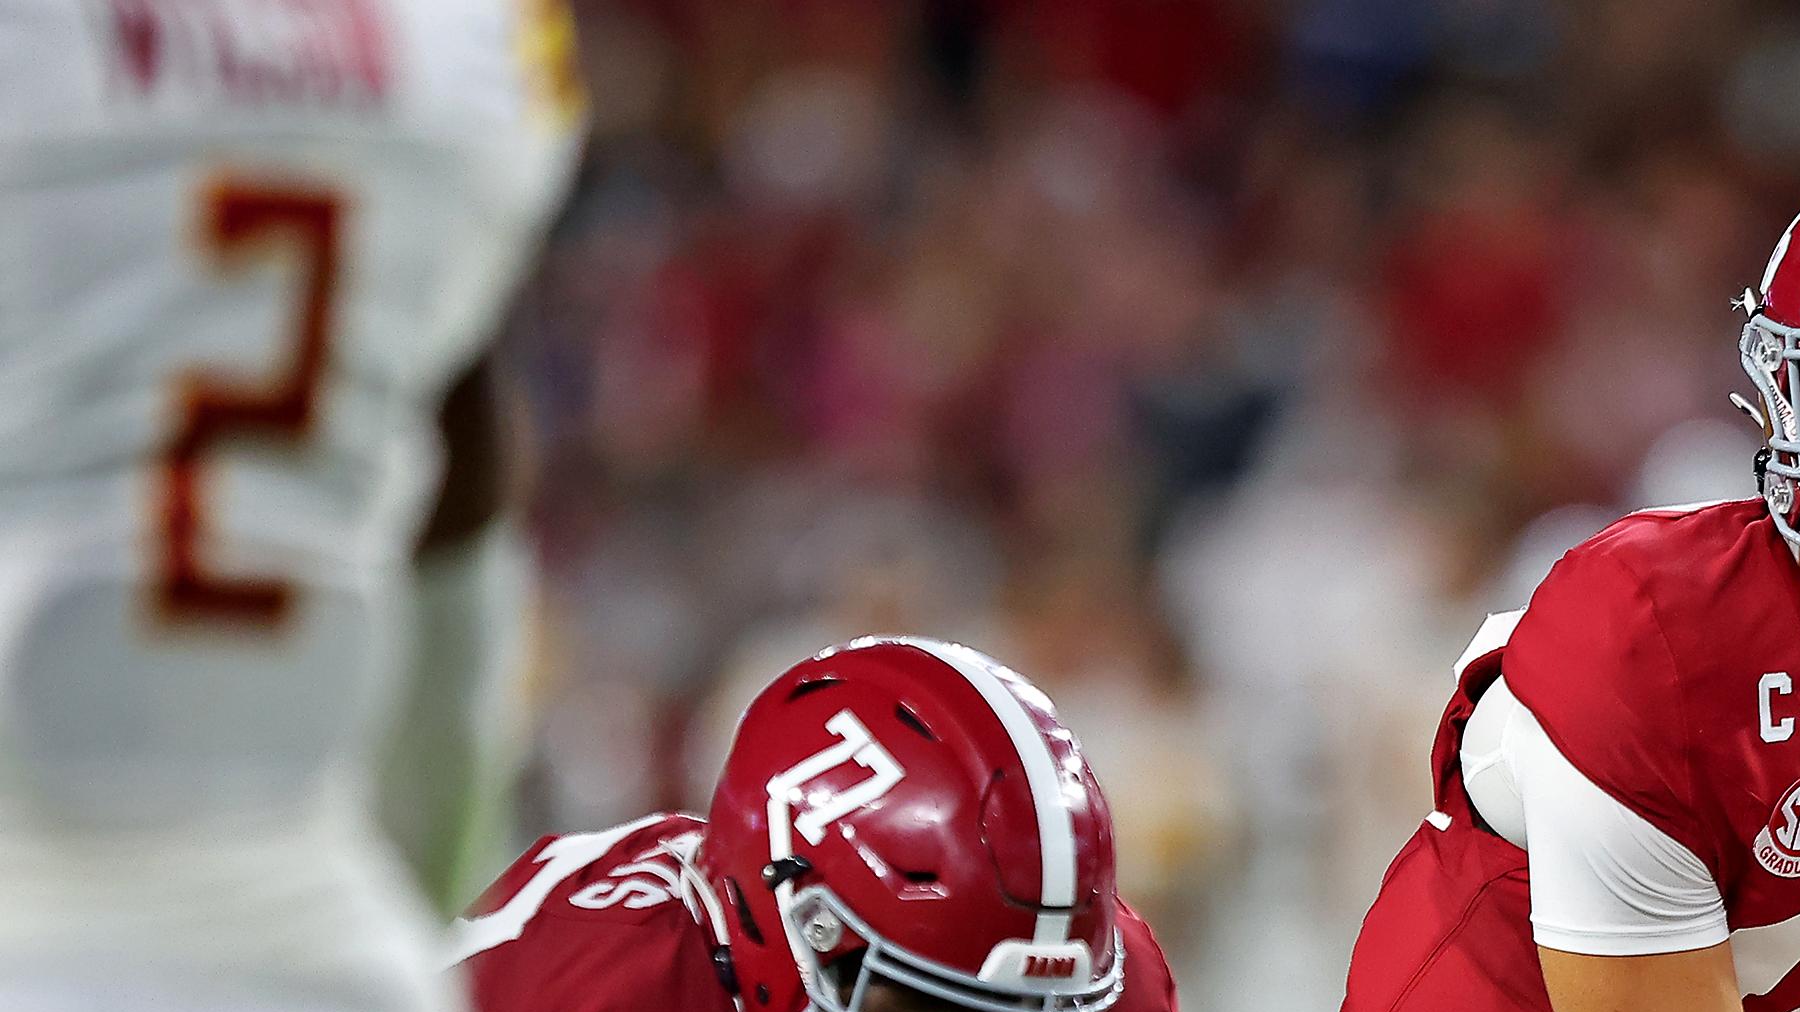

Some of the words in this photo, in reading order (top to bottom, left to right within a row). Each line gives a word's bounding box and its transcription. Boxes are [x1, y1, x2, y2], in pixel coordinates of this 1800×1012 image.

[148, 178, 342, 638] 2
[765, 707, 906, 847] 77
[1758, 672, 1793, 743] C
